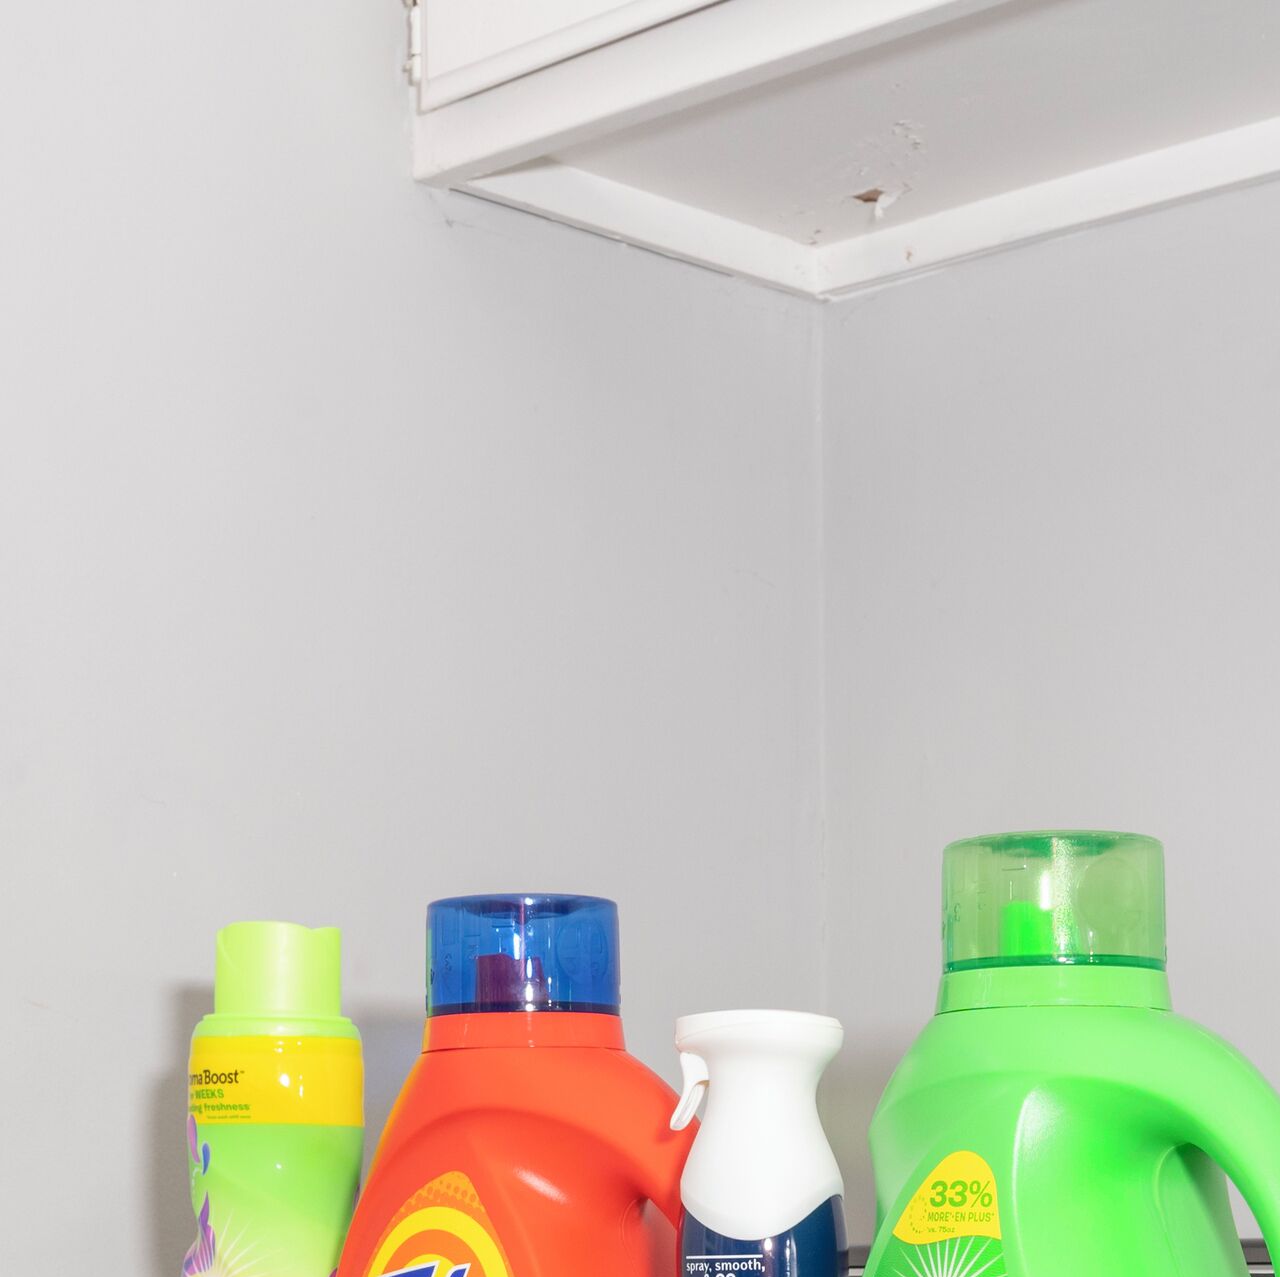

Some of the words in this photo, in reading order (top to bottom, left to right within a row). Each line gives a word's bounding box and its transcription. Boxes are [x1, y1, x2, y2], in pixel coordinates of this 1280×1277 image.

[930, 1180, 992, 1207] 33%
[686, 1260, 712, 1274] spray,
[715, 1259, 765, 1272] smooth,
